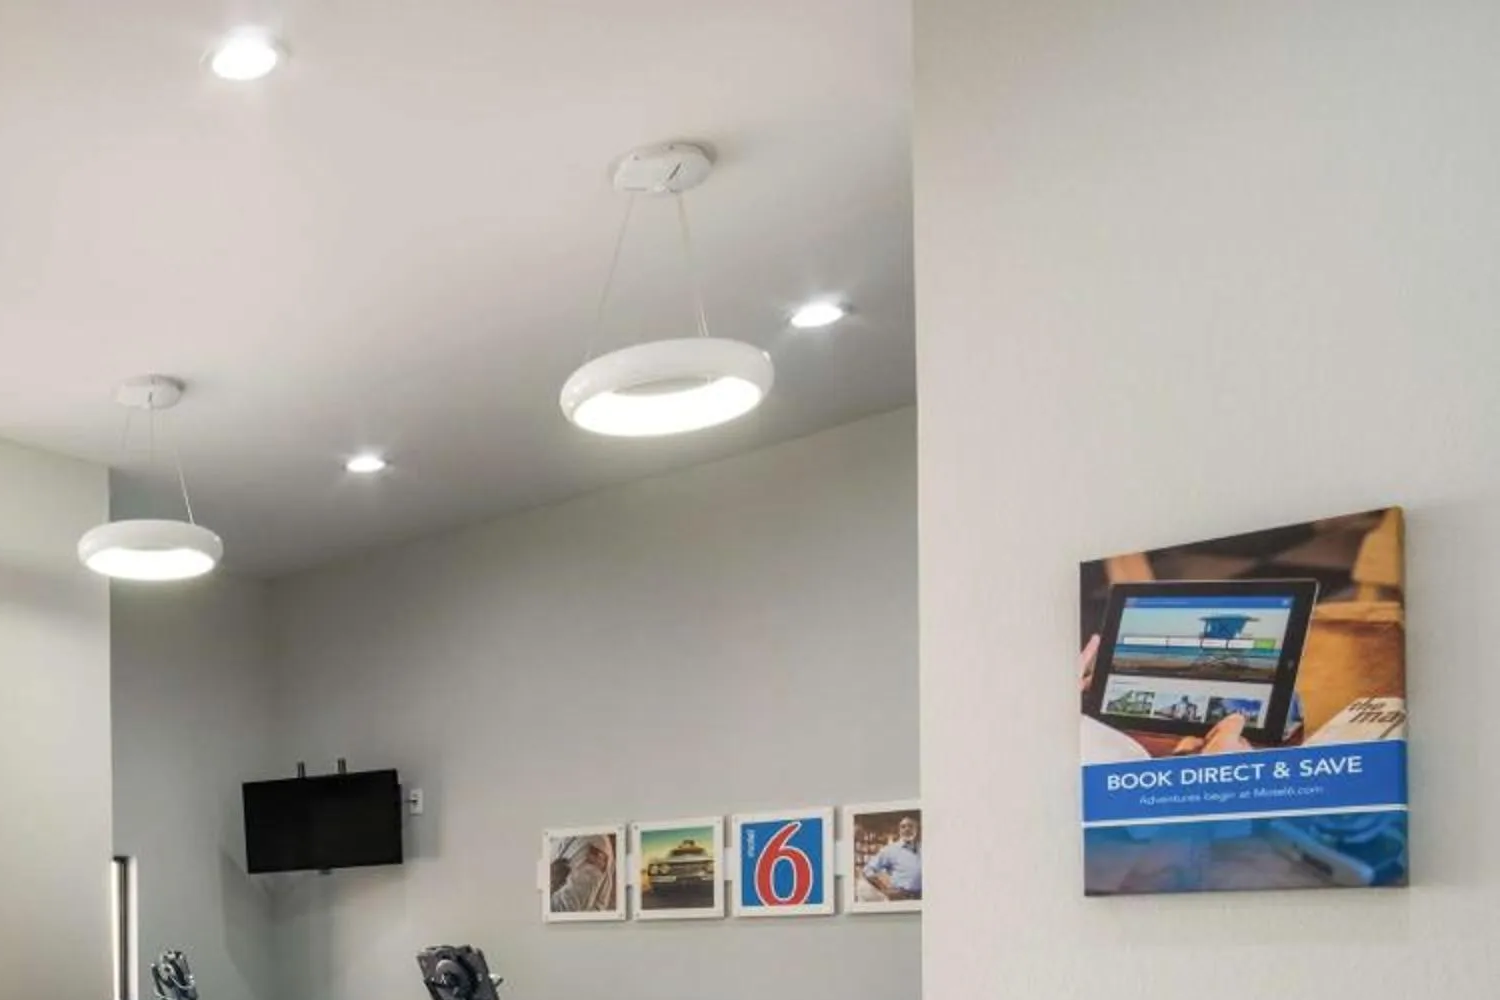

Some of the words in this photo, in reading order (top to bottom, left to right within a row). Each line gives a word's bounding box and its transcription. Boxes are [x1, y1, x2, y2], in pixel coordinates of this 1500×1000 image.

[1107, 769, 1173, 791] BOOK
[1181, 763, 1265, 785] DIRECT
[1273, 761, 1290, 779] &
[1299, 756, 1363, 777] SAVE
[754, 821, 813, 907] 6
